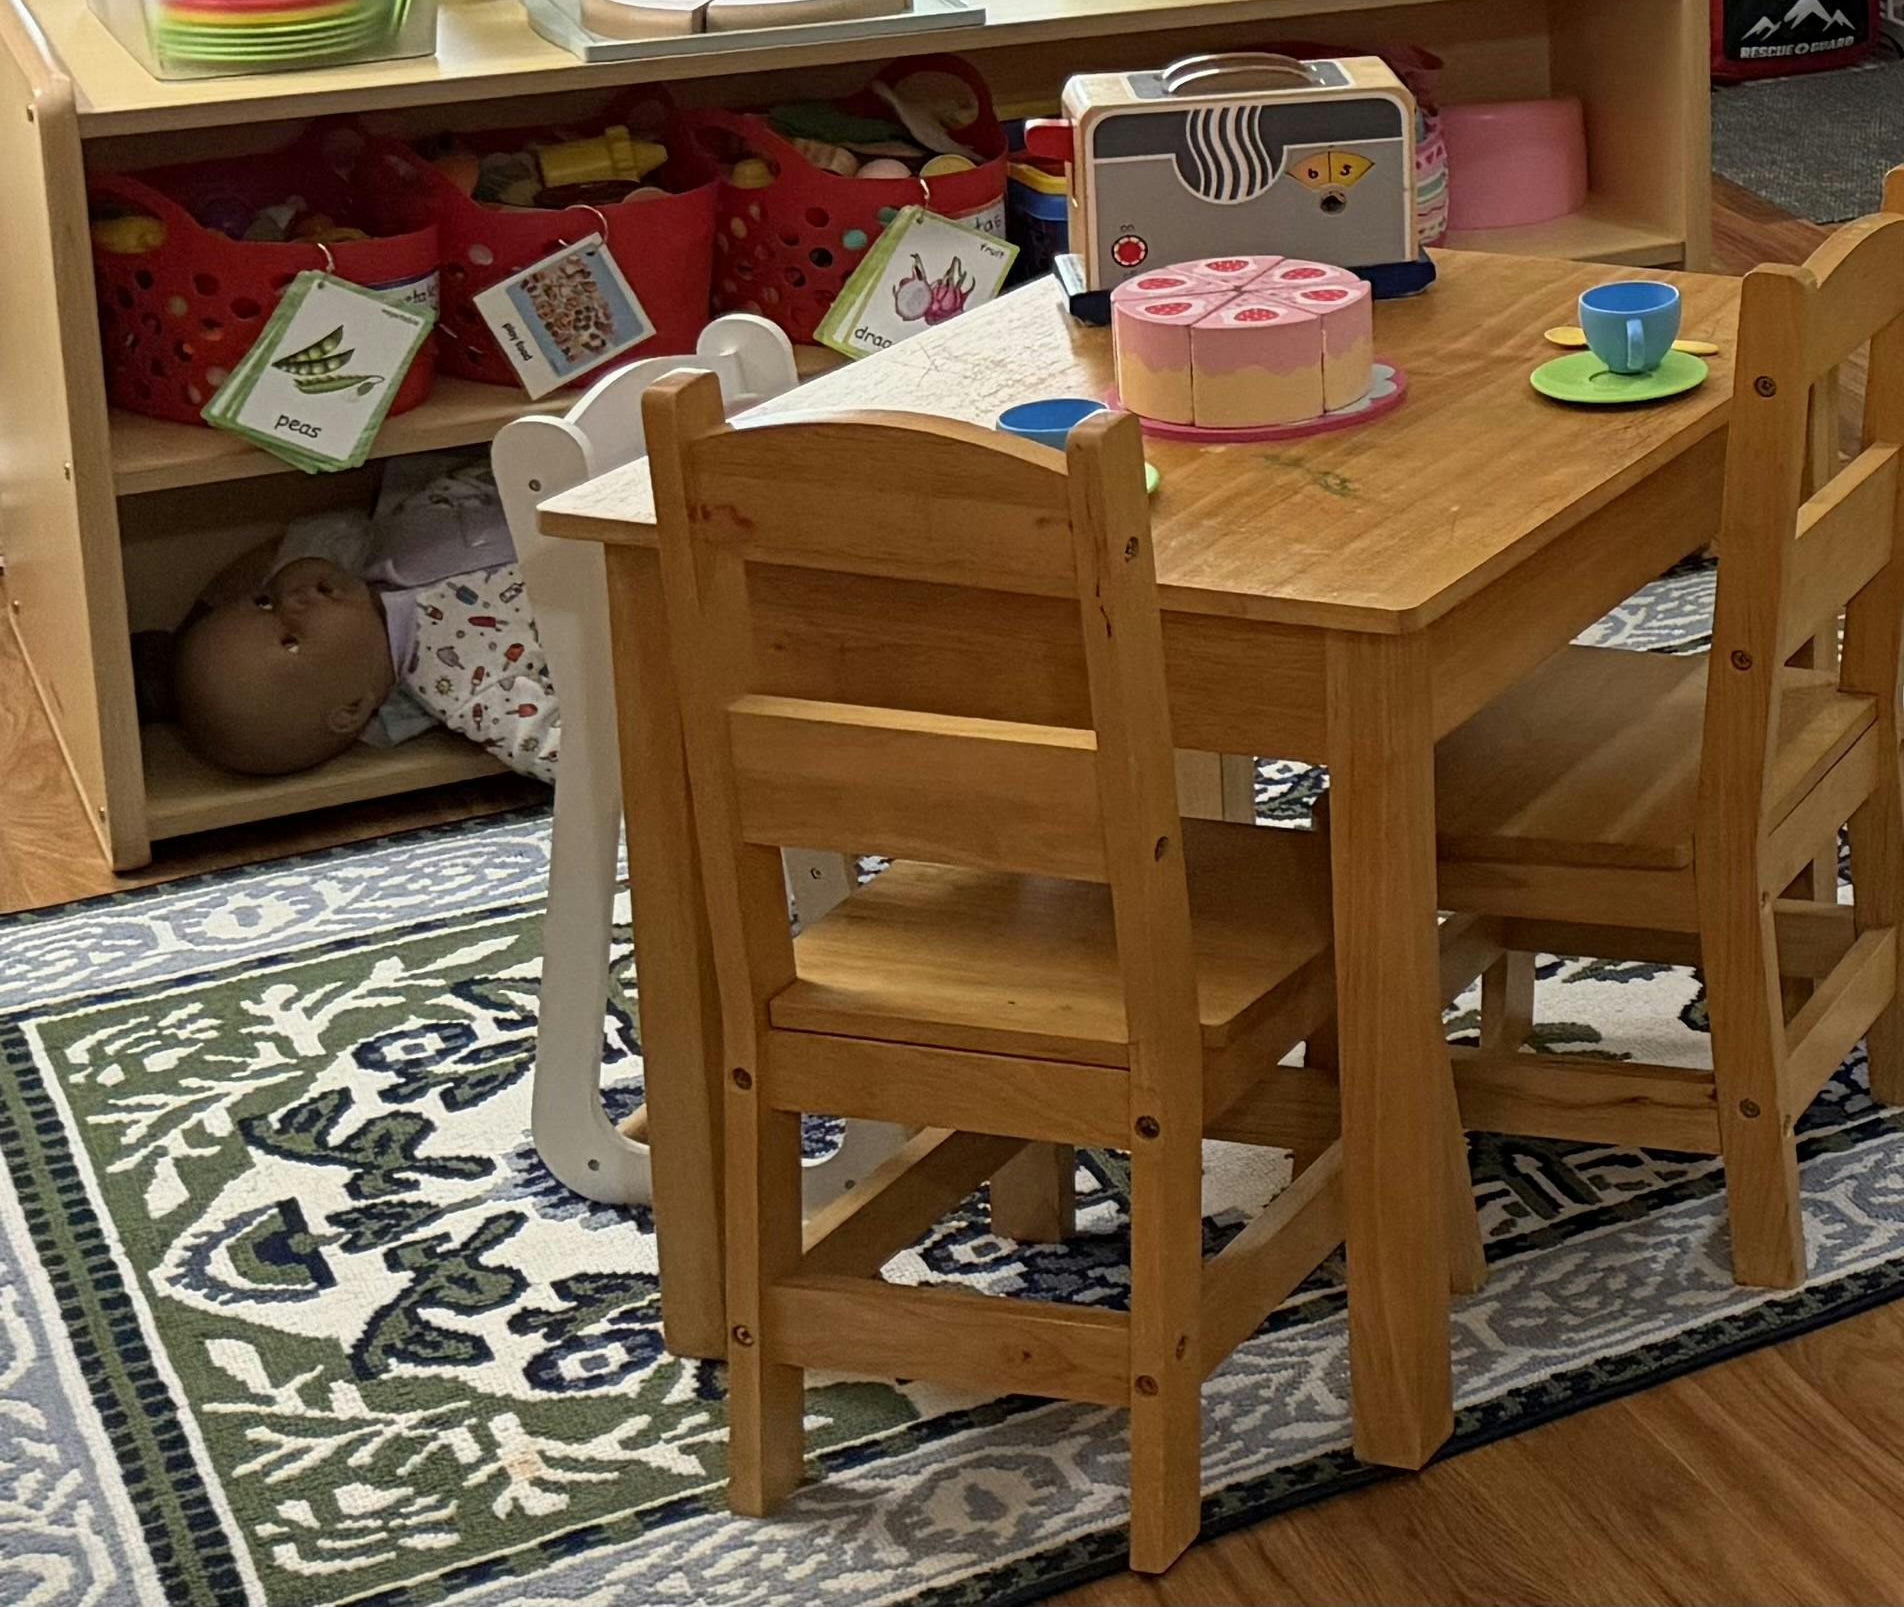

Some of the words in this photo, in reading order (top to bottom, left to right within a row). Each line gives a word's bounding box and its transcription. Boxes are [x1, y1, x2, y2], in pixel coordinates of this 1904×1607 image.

[1740, 44, 1794, 59] RESCUE
[1810, 36, 1855, 54] GUARD
[979, 242, 1004, 258] fruit
[502, 322, 516, 340] play
[516, 340, 531, 362] food
[273, 412, 322, 440] peas
